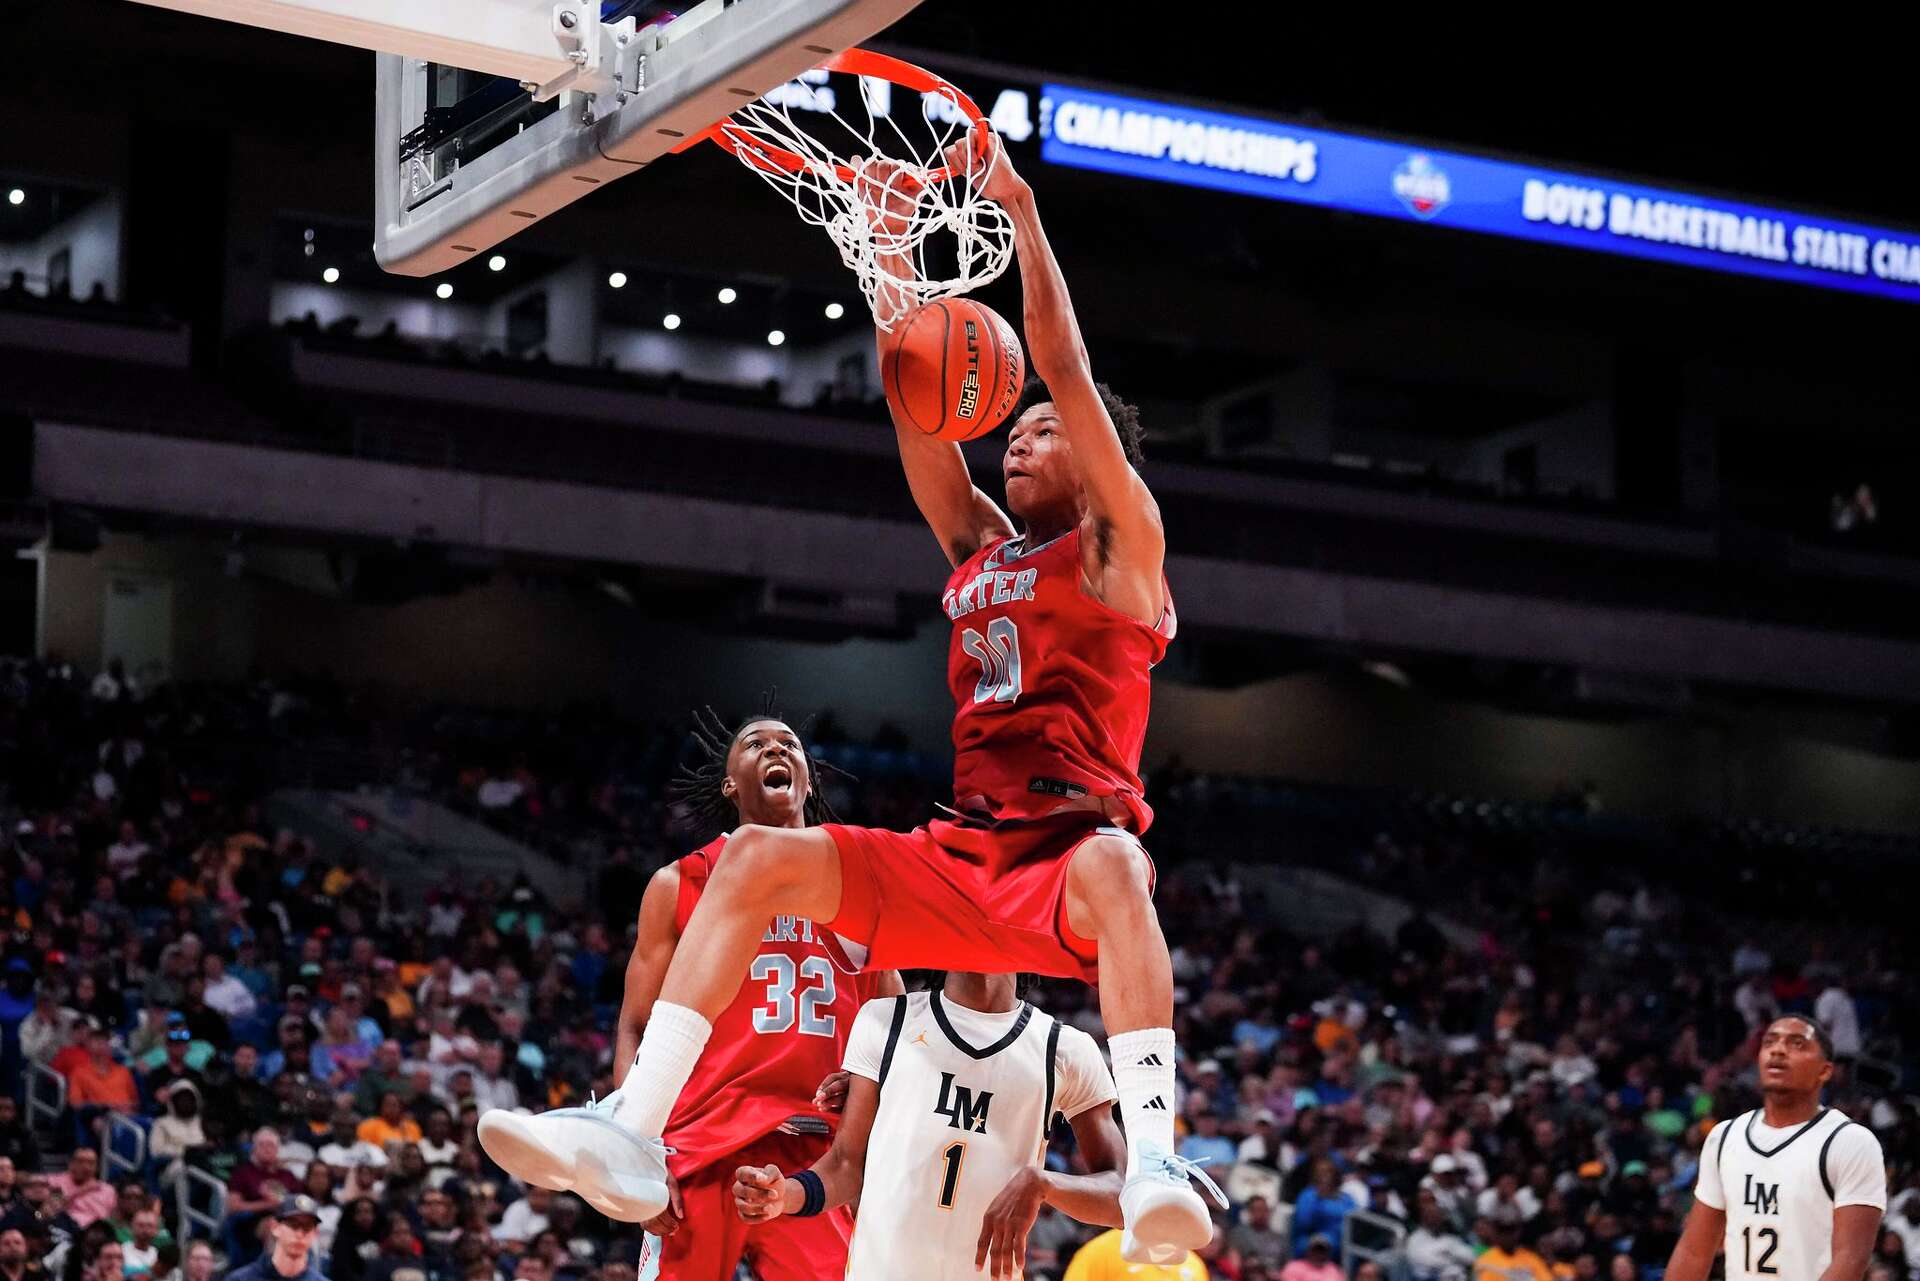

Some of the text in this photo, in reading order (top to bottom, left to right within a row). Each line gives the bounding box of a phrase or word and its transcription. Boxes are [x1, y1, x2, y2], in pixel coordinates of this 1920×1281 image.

[990, 90, 1032, 141] 4
[1055, 101, 1317, 182] CHAMPIONSHIPS
[1522, 179, 1605, 231] BOYS
[1609, 194, 1788, 261] BASKETBALL
[1793, 225, 1868, 274] STATE
[958, 320, 980, 419] ELITE PRO
[750, 953, 837, 1038] 32
[934, 1071, 994, 1134] LM
[938, 1140, 967, 1210] 1
[1743, 1174, 1779, 1215] LM
[1742, 1226, 1779, 1275] 12
